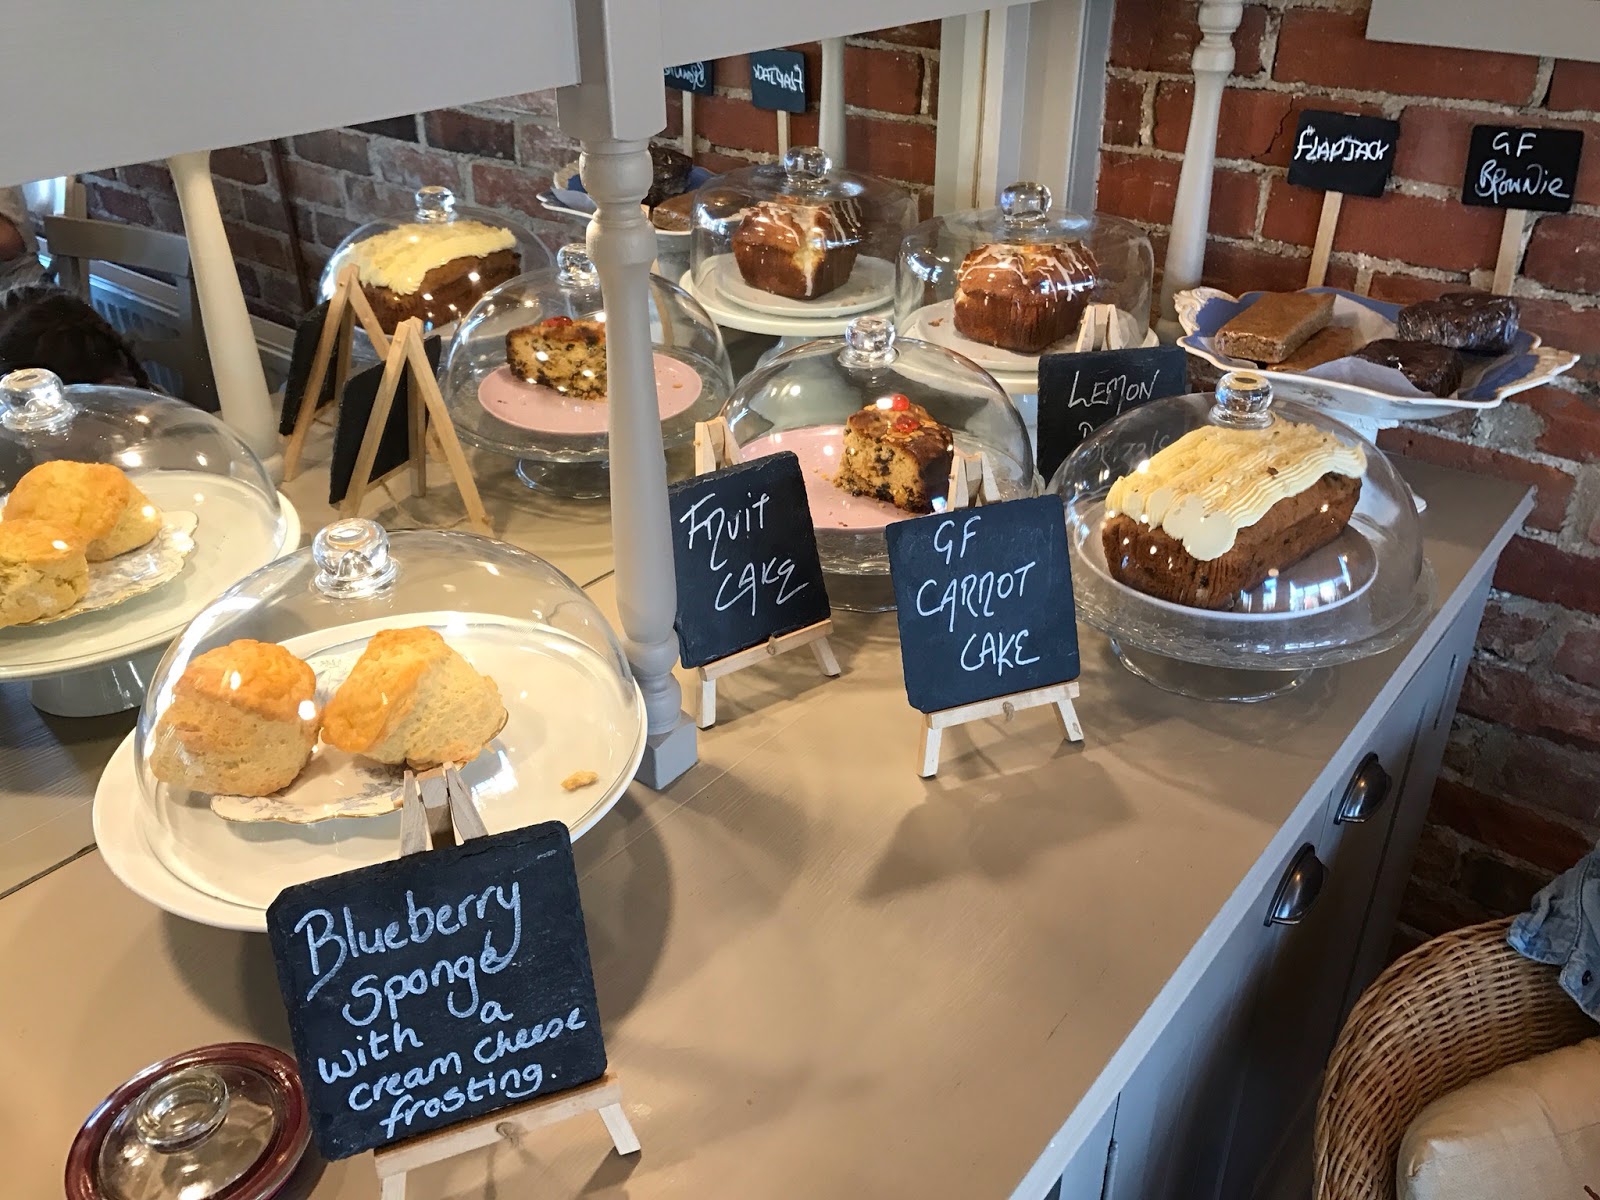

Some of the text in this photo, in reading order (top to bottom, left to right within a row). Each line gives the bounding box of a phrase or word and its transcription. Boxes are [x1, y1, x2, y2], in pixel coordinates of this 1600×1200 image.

[1492, 131, 1537, 157] GF
[1068, 369, 1161, 416] LEMON
[933, 515, 981, 565] GF
[916, 561, 1036, 632] CARROT
[960, 629, 1041, 677] CAKE
[294, 881, 523, 1002] Blueberry
[317, 1001, 514, 1084] with a
[347, 1050, 463, 1112] cream
[379, 1063, 558, 1139] frosting.
